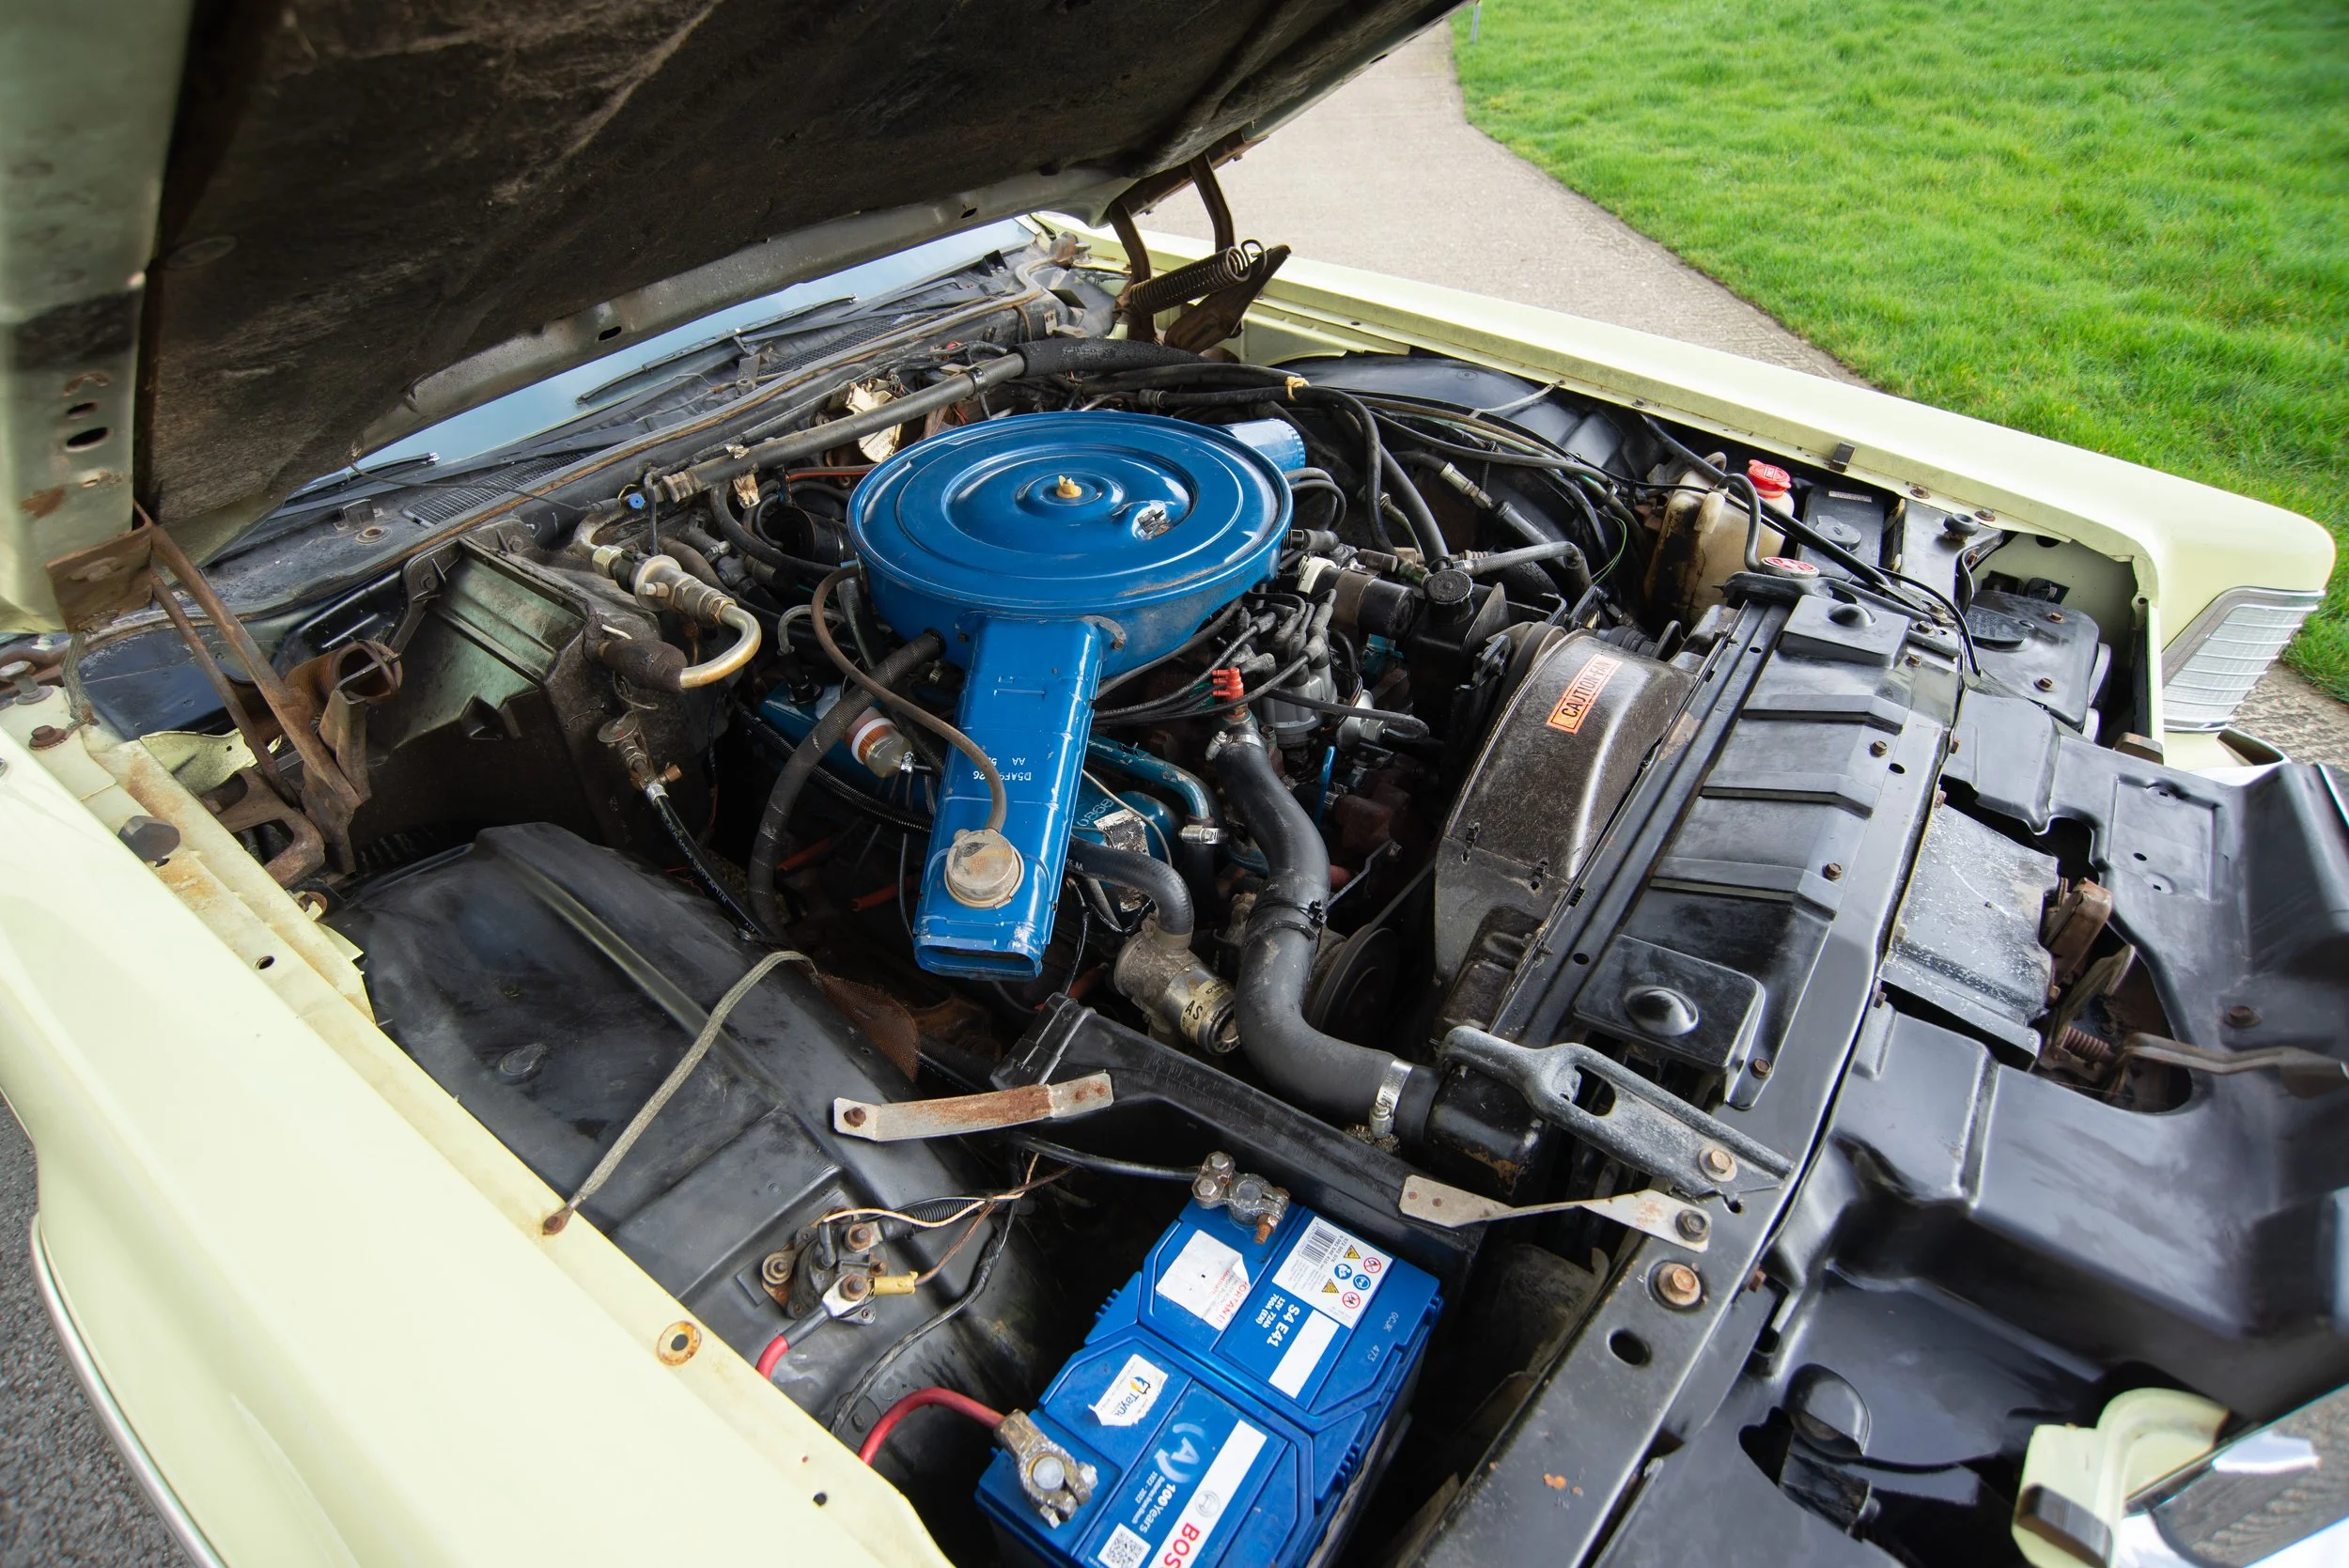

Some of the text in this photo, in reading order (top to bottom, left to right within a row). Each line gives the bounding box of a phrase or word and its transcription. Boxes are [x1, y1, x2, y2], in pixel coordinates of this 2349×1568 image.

[1011, 757, 1026, 766] AA
[1274, 1296, 1285, 1311] 12V
[1283, 1304, 1300, 1323] S4
[1267, 1322, 1289, 1347] E41
[1367, 1344, 1380, 1361] 473
